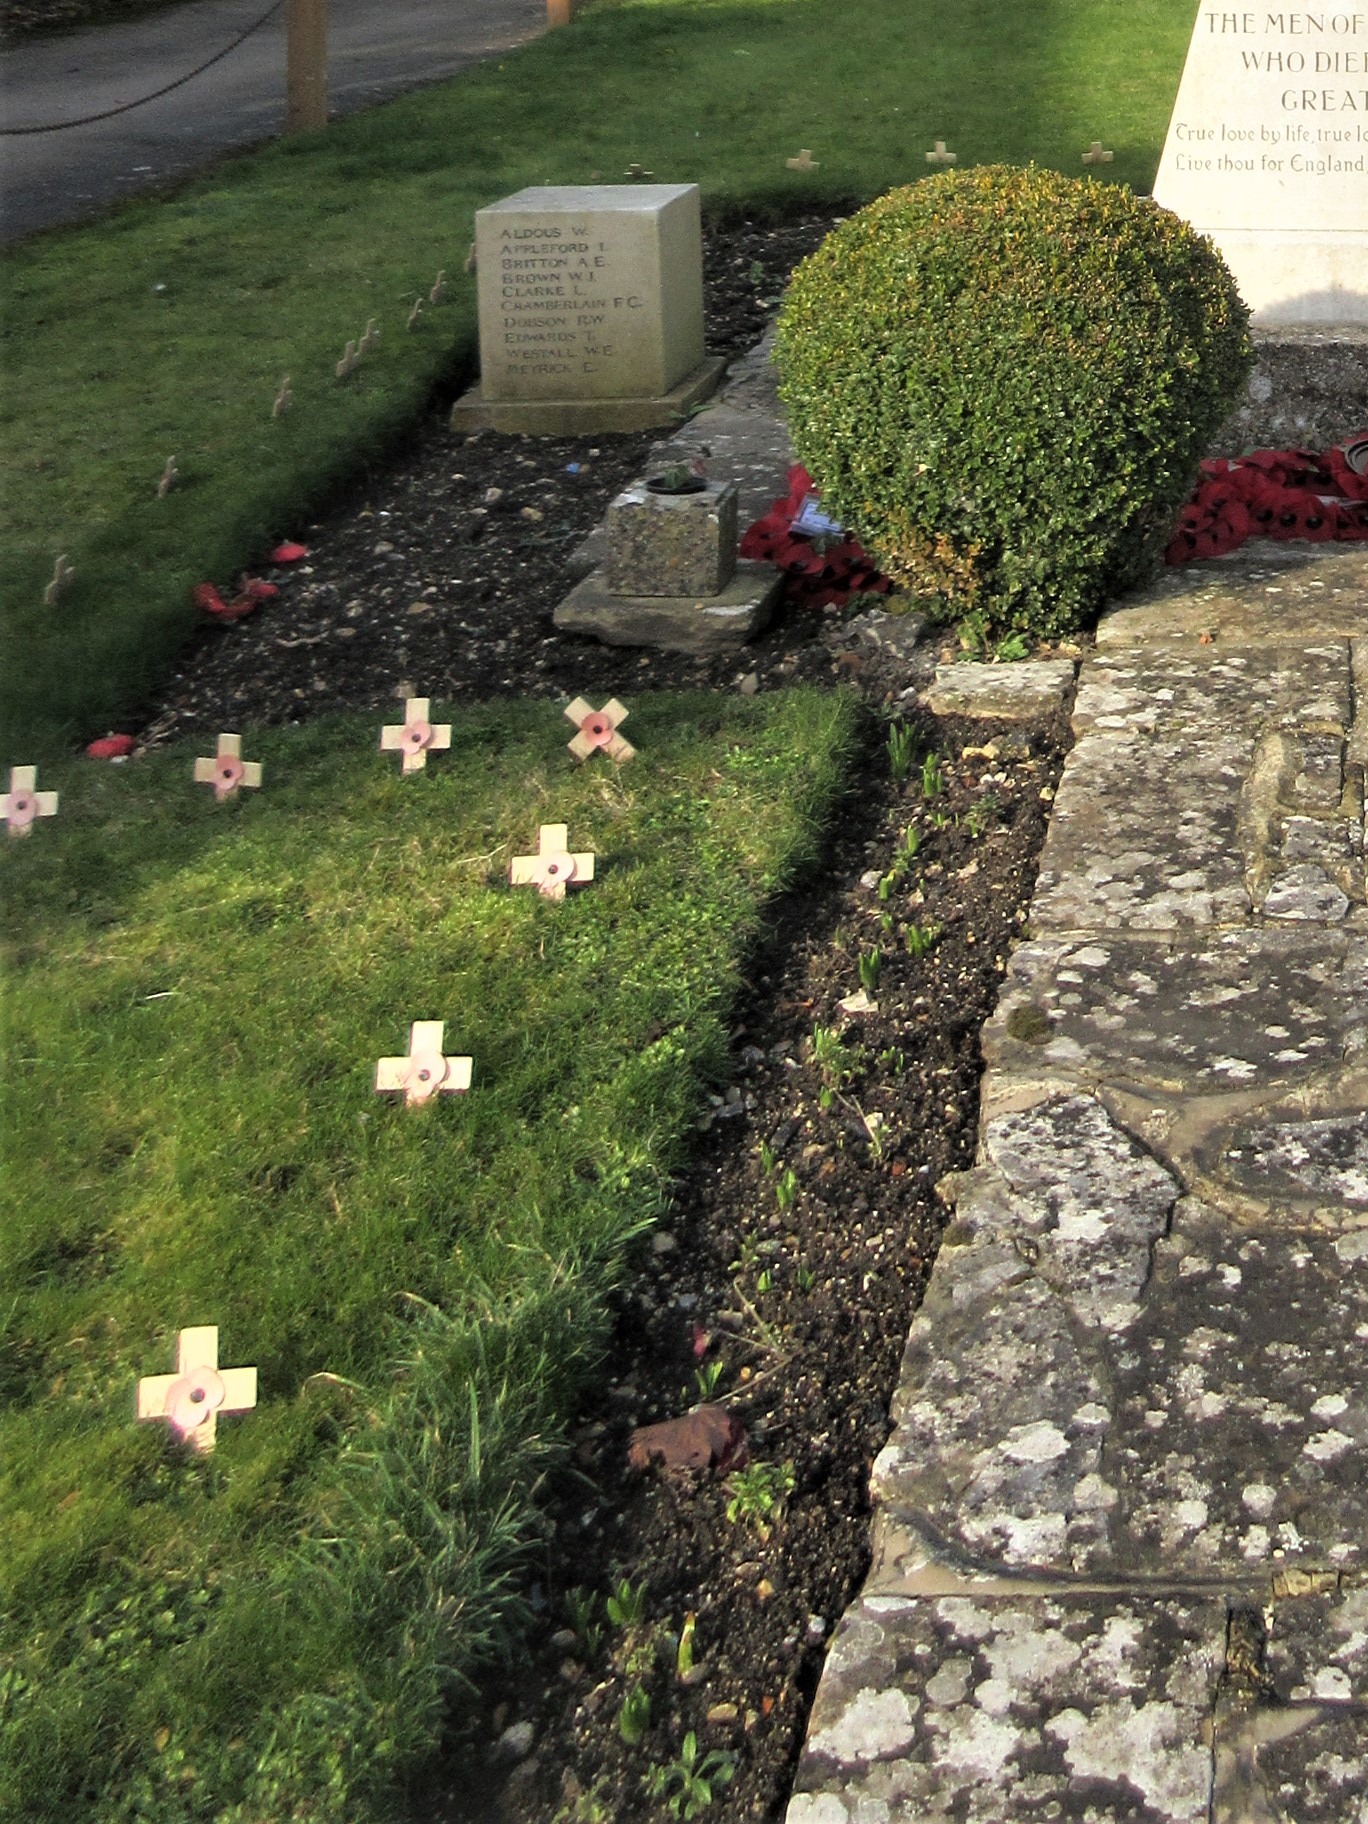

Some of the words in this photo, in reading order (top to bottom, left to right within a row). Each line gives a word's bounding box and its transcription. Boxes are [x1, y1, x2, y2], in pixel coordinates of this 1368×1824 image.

[1205, 13, 1255, 34] THE
[1265, 13, 1324, 35] MEN
[1331, 13, 1365, 35] OF
[1241, 51, 1305, 73] WHO
[1176, 123, 1215, 141] True
[1221, 124, 1255, 142] love
[1261, 125, 1280, 145] by
[1286, 125, 1315, 145] life,
[1317, 126, 1351, 142] true
[1176, 153, 1212, 171] Live
[1217, 154, 1254, 172] thou
[1262, 154, 1285, 171] for
[501, 228, 562, 239] ALDOUS
[502, 259, 568, 270] BRITTON
[503, 273, 561, 284] BROWN
[503, 286, 565, 297] CLARKE
[502, 299, 606, 311] CHAMBERLAIN
